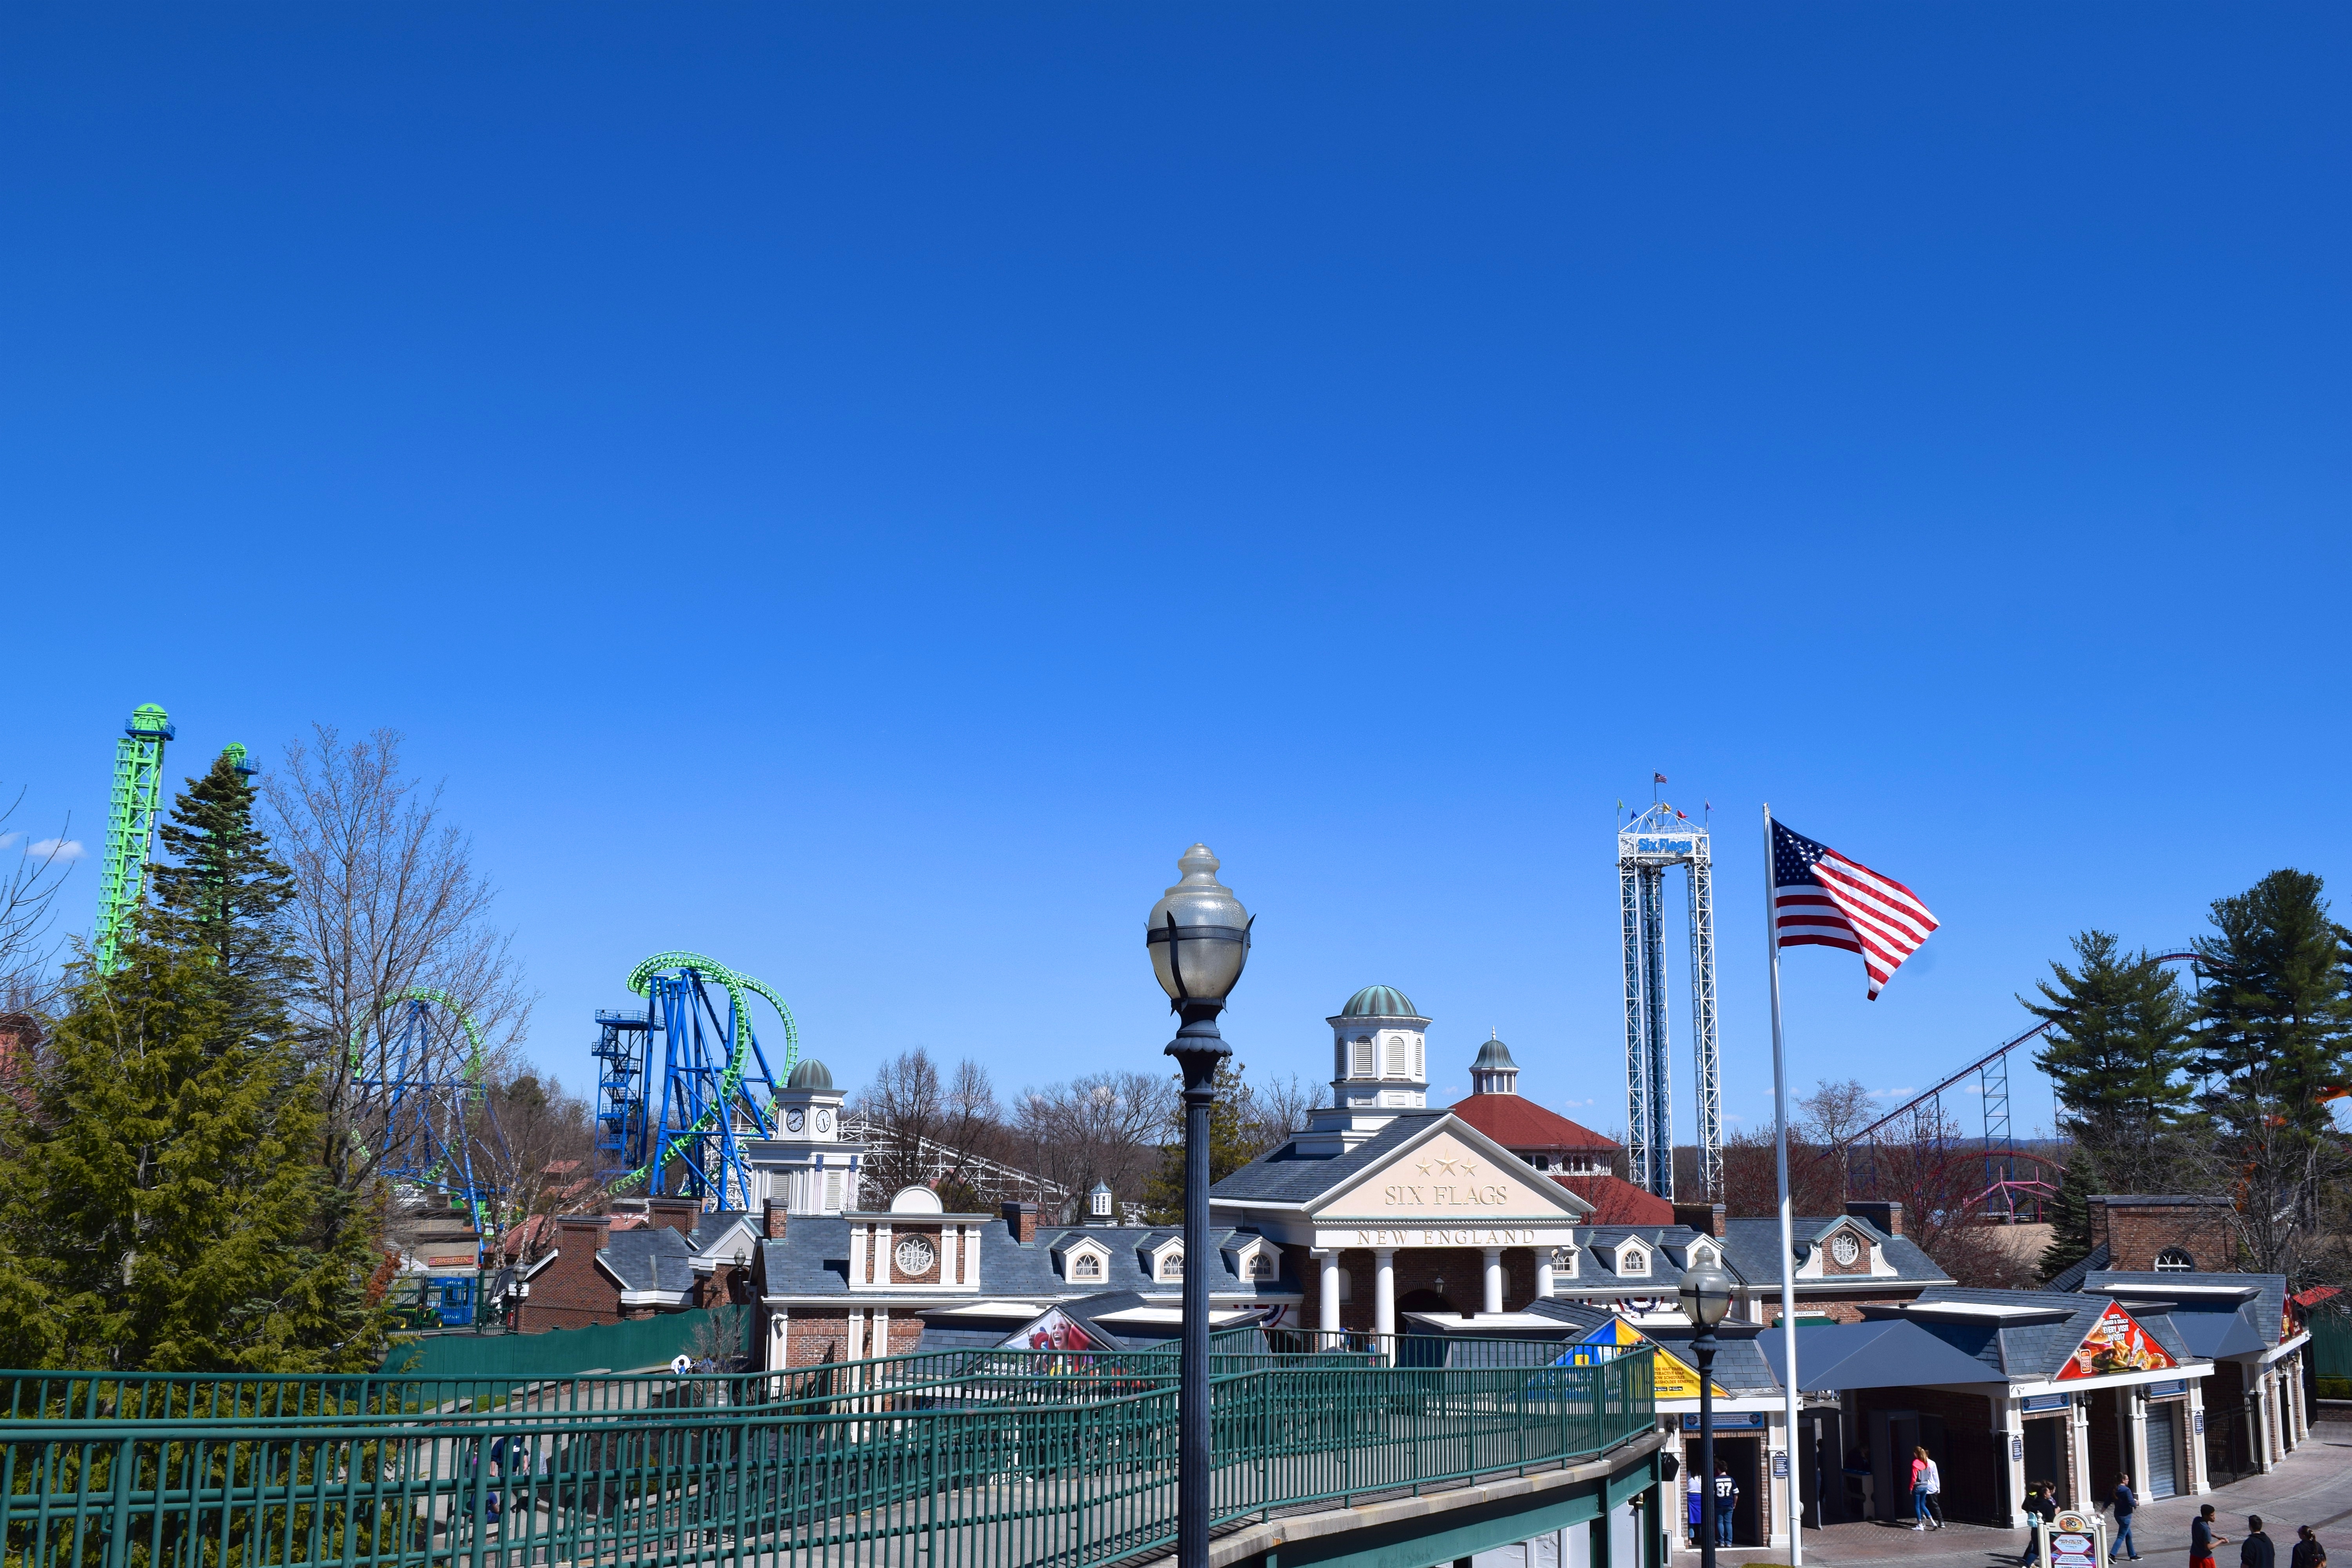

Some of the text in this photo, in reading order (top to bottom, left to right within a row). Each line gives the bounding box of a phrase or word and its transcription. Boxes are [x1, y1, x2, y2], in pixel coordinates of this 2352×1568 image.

[1638, 838, 1693, 854] Six Flags
[1385, 1185, 1507, 1205] SIX FLAGS
[1357, 1229, 1535, 1245] NEW ENGLAND
[1002, 1362, 1031, 1372] Waiing.
[1716, 1482, 1732, 1497] 87
